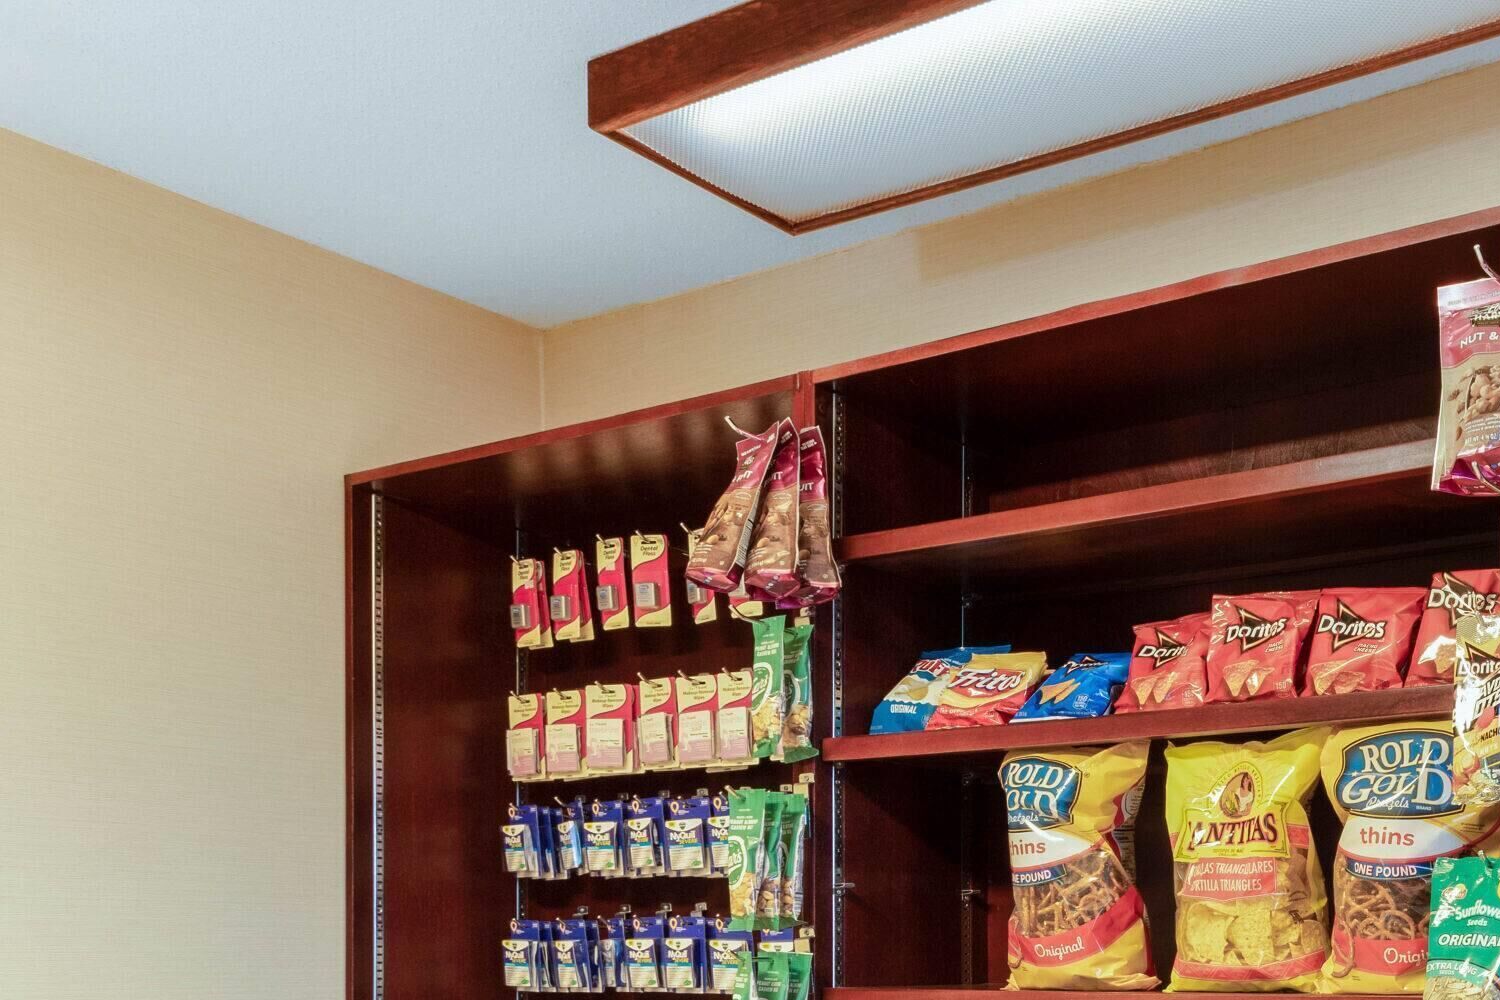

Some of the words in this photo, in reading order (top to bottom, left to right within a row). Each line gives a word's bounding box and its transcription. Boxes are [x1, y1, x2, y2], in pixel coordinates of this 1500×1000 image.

[1460, 332, 1484, 348] NUT
[1489, 331, 1499, 341] &
[1426, 587, 1500, 613] Doritos
[1224, 616, 1288, 643] Doritos
[1316, 612, 1387, 640] Doritos
[950, 667, 1026, 692] Fritos
[890, 704, 917, 715] ORIGINAL
[1359, 737, 1448, 774] ROLD
[1006, 761, 1063, 791] ROLD
[1341, 766, 1453, 805] GOLD
[1005, 788, 1059, 820] OLD
[588, 833, 610, 844] NyQuil
[631, 831, 647, 842] NyQuil
[670, 831, 696, 843] NyQuil
[1360, 826, 1415, 847] thins
[1020, 869, 1053, 884] POUND
[1354, 862, 1374, 875] ONE
[1375, 864, 1417, 877] POUND
[1220, 878, 1262, 892] TRIANGLES
[1466, 918, 1488, 927] Seeds
[506, 950, 525, 961] NyQuil
[630, 949, 649, 961] NyQuil
[668, 949, 687, 960] NyQuil
[1034, 936, 1084, 961] Original
[1426, 960, 1452, 973] EXTRA
